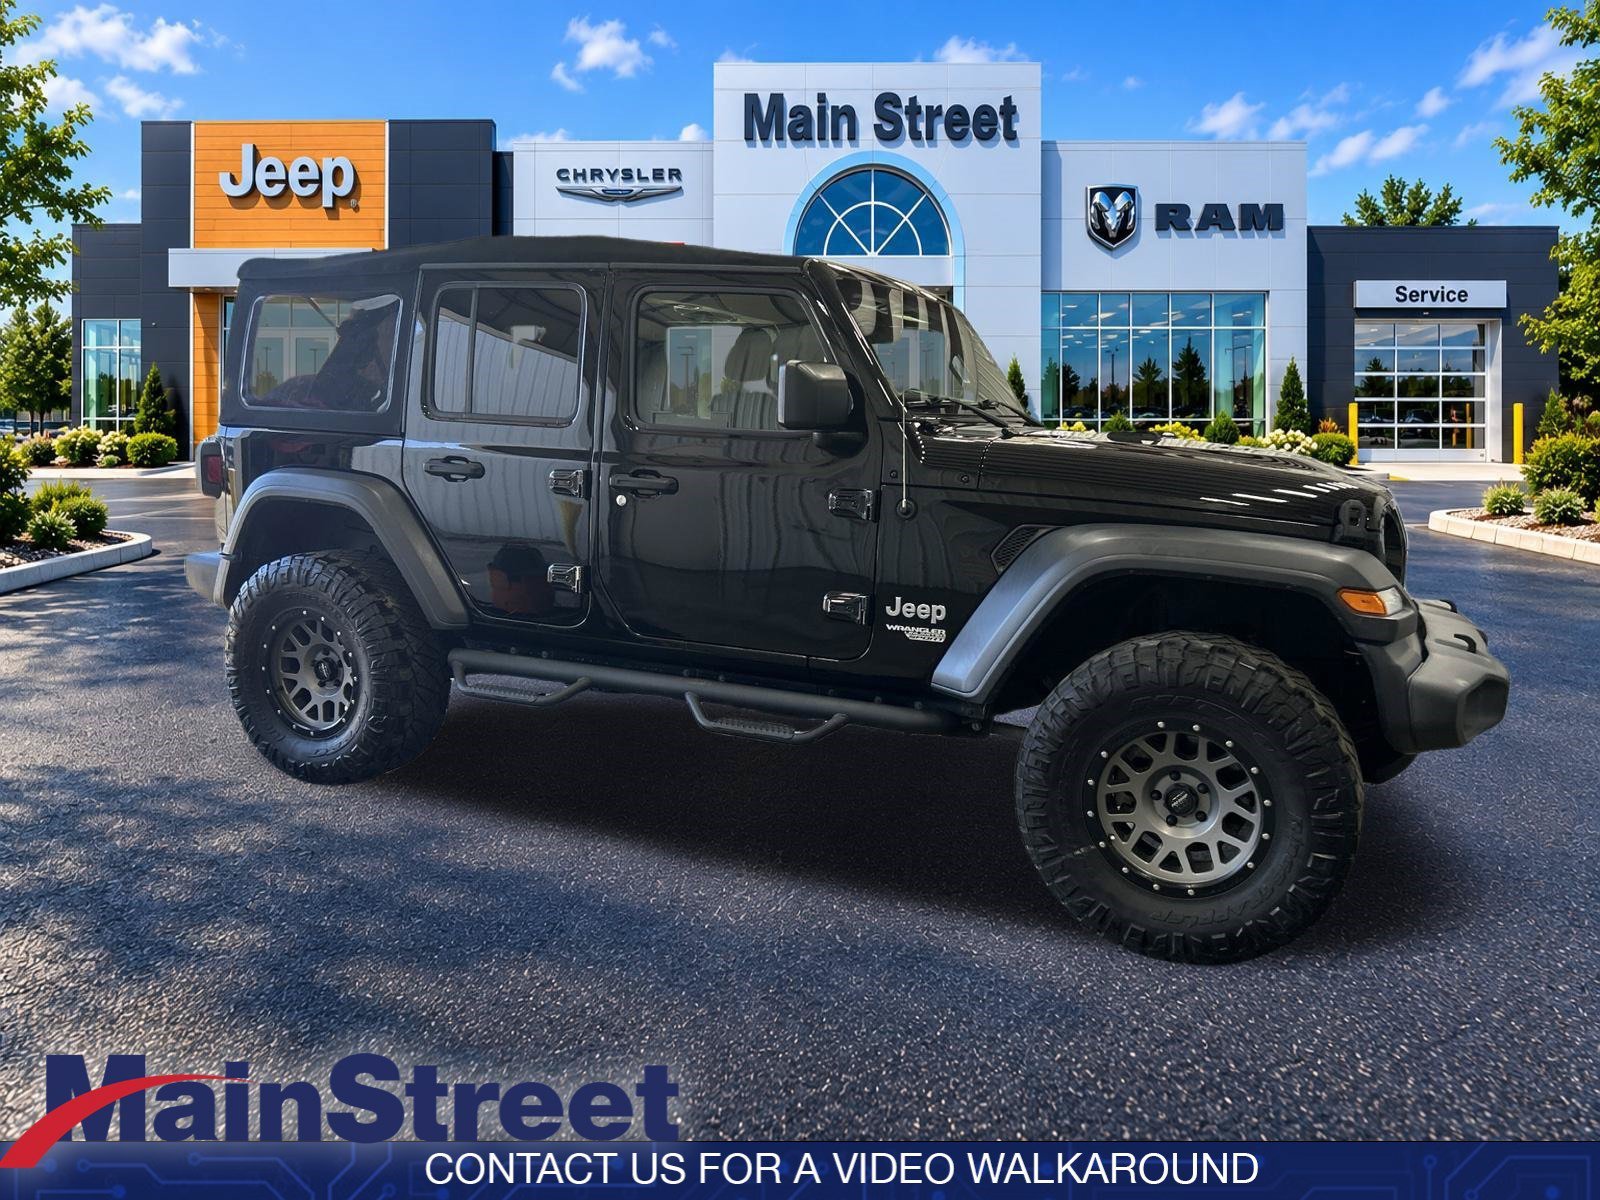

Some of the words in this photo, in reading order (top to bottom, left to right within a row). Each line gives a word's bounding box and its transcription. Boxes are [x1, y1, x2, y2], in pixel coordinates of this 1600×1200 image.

[744, 92, 856, 141] Main
[873, 91, 1018, 141] Street
[218, 143, 355, 208] Jeep
[556, 168, 683, 182] CHRYSLER
[1155, 203, 1284, 231] RAM
[1395, 285, 1469, 303] Service
[885, 596, 947, 625] Jeep
[885, 623, 946, 635] WRANGLER
